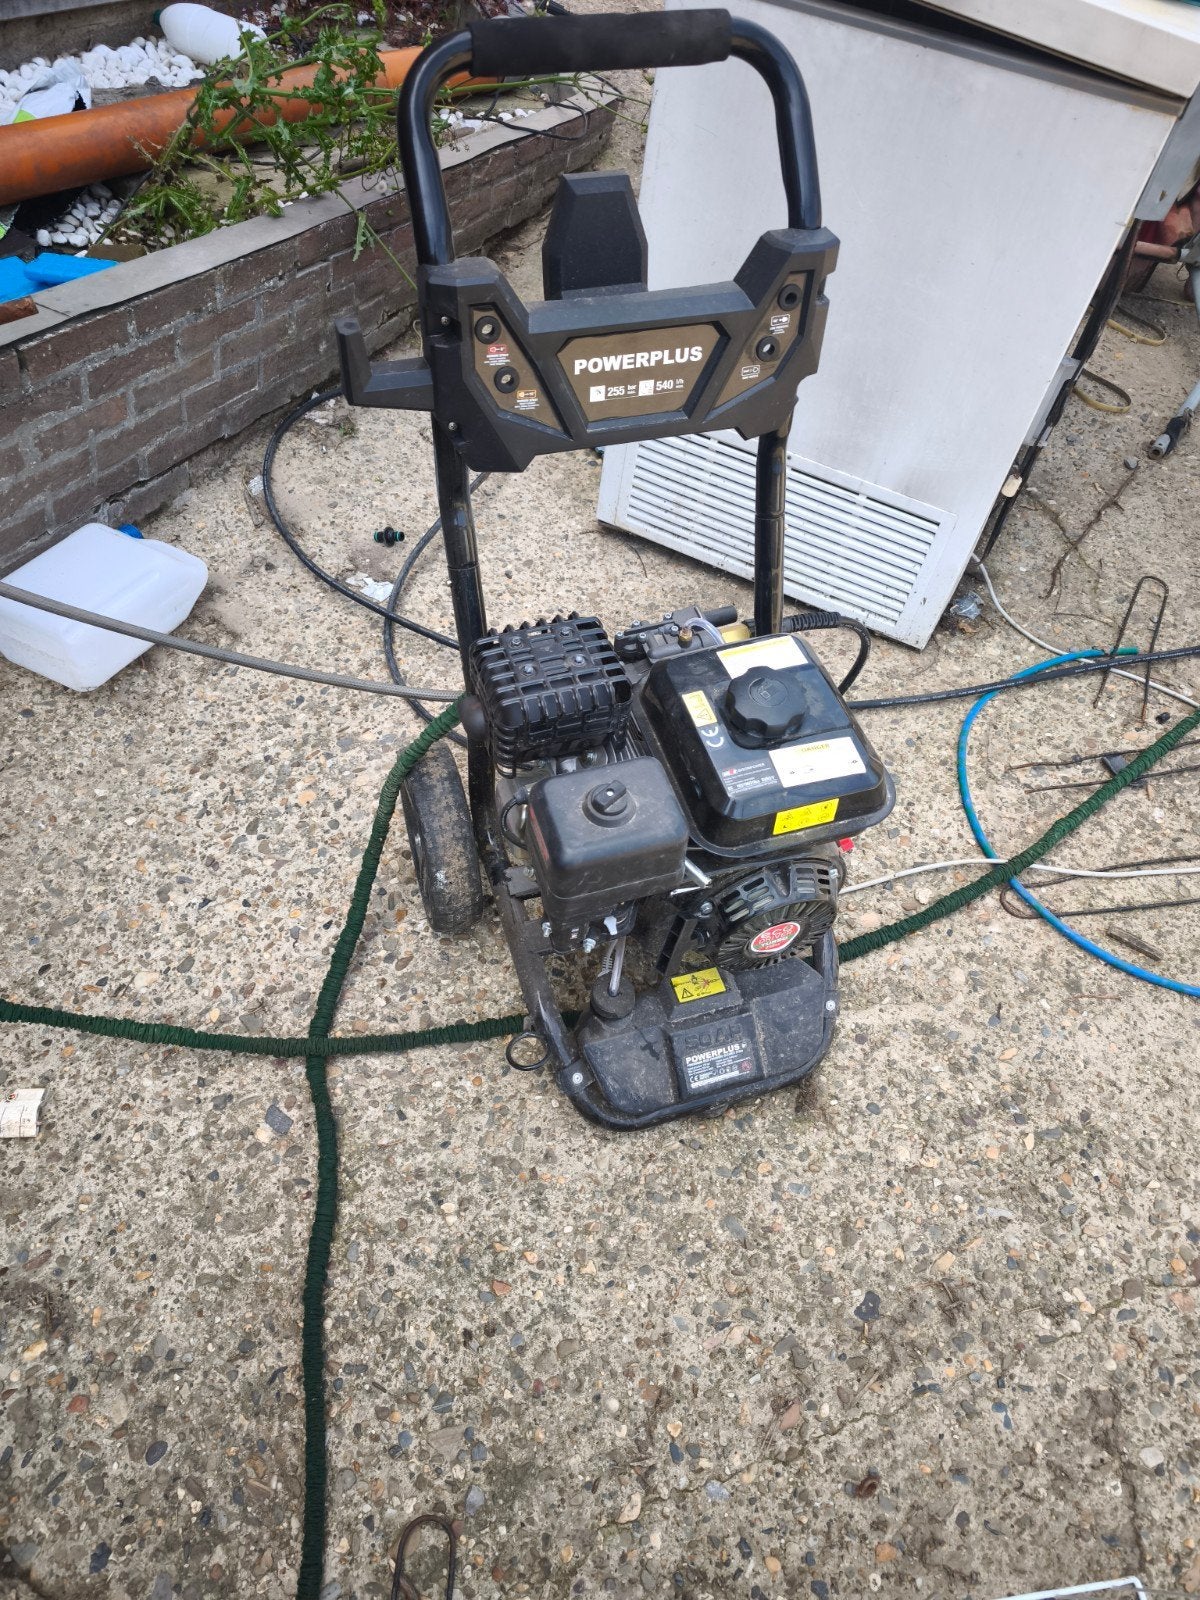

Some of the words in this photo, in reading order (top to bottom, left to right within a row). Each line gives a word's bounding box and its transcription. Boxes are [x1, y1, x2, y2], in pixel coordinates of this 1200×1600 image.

[574, 346, 703, 375] POWERPLUS
[607, 385, 625, 397] 255
[655, 379, 674, 391] 540
[685, 1043, 741, 1065] POWERPLUS
